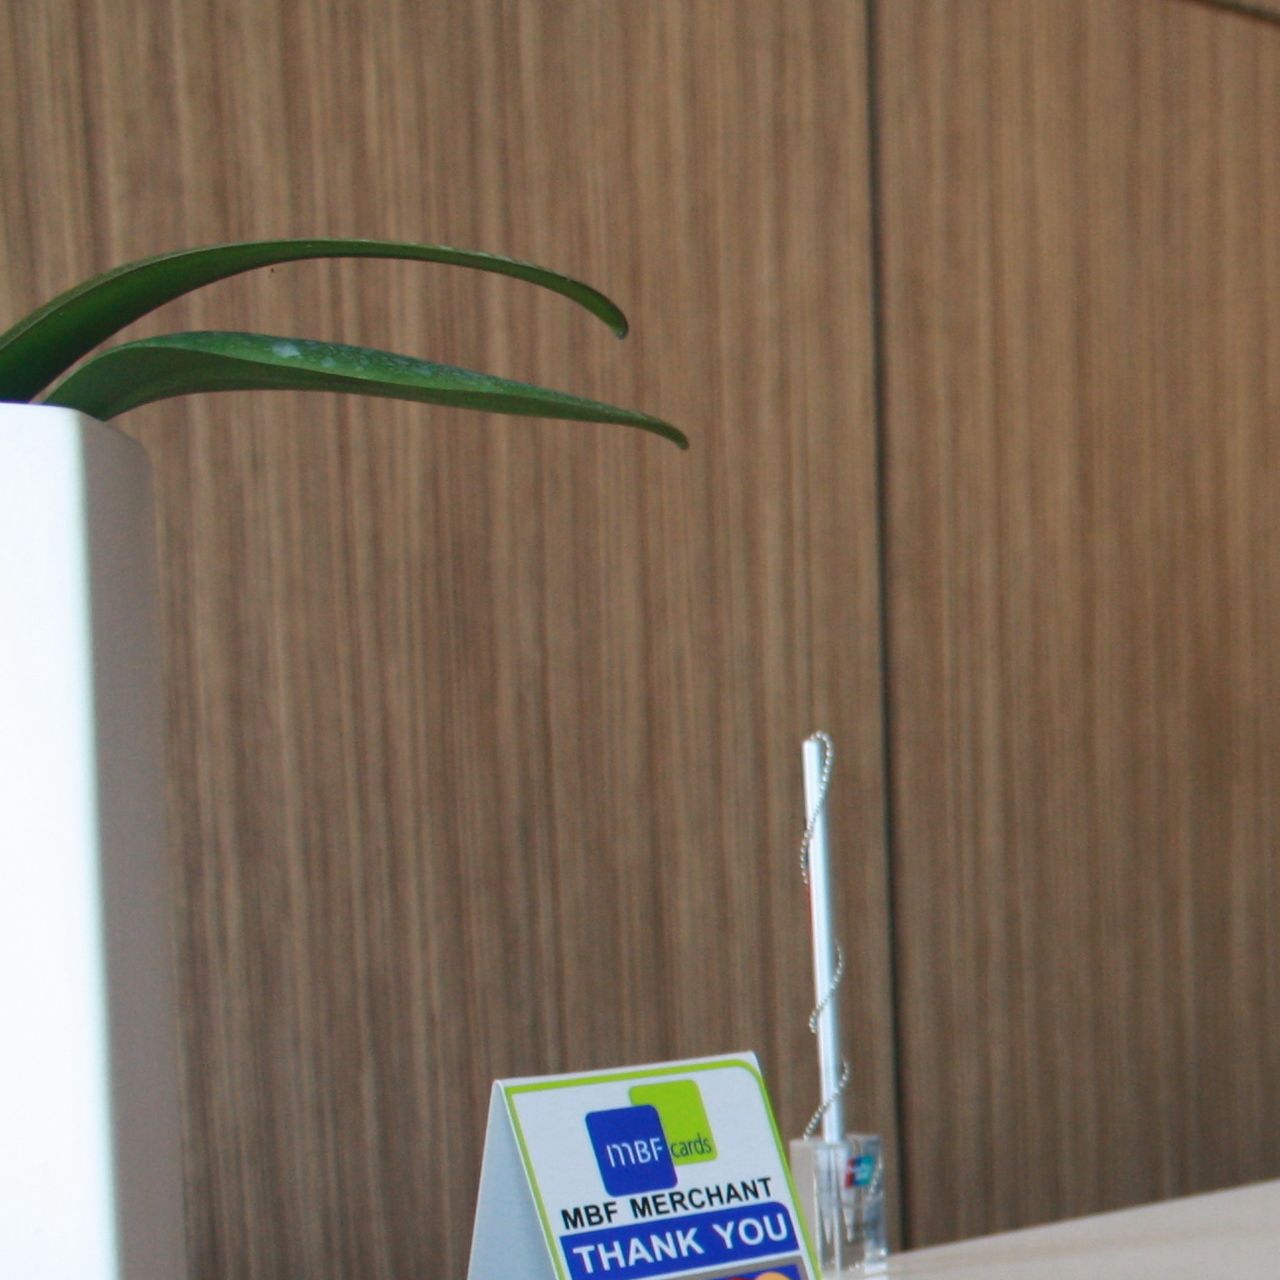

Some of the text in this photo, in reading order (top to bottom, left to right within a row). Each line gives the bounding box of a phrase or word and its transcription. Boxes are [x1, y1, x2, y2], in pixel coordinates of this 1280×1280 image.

[670, 1132, 712, 1159] cards
[561, 1177, 772, 1230] MBF MERCHANT
[573, 1213, 788, 1275] THANK YOU
